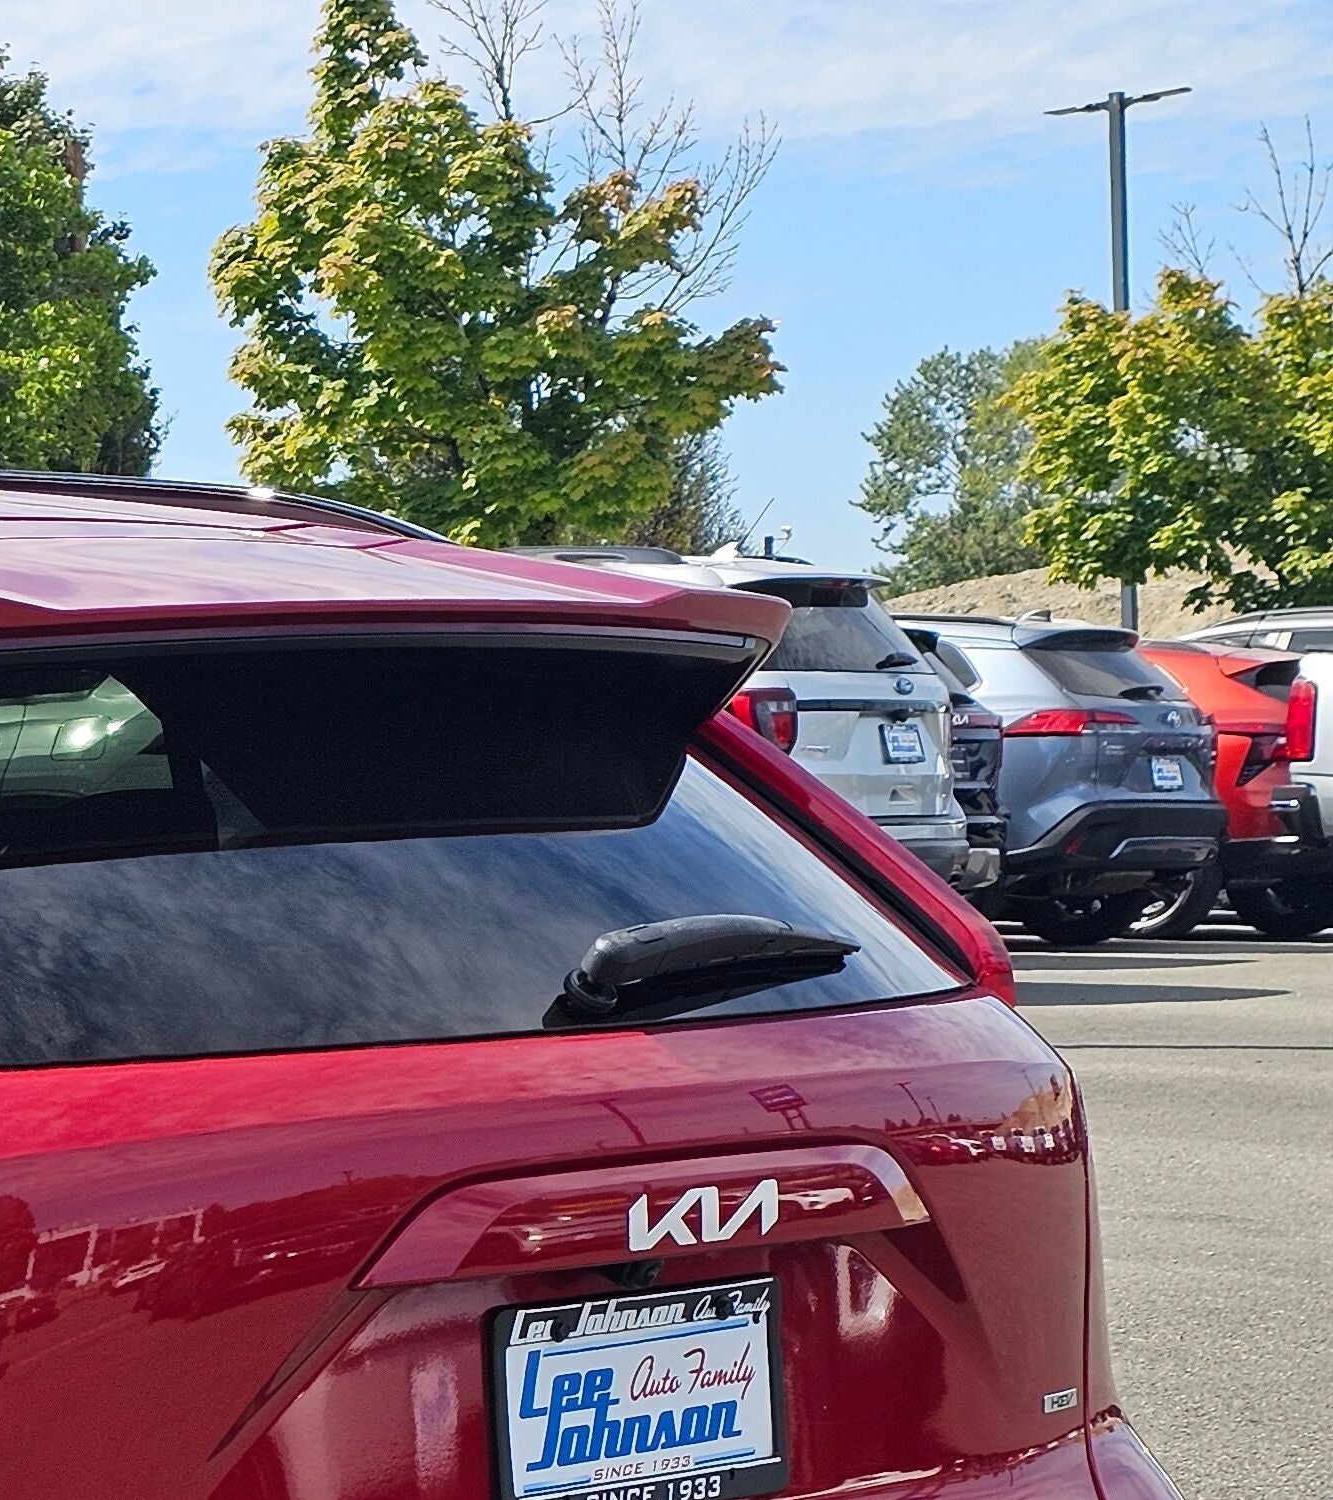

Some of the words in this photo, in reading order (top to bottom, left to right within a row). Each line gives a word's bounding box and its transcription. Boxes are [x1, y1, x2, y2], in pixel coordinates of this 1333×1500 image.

[628, 1178, 779, 1252] KIA
[569, 1300, 687, 1337] Johnson
[728, 1286, 771, 1322] Family
[519, 1350, 620, 1419] Lee
[630, 1355, 682, 1401] Auto
[683, 1341, 756, 1400] Family
[525, 1395, 742, 1472] Johnson
[593, 1462, 642, 1481] SINCE
[652, 1455, 692, 1472] 1933
